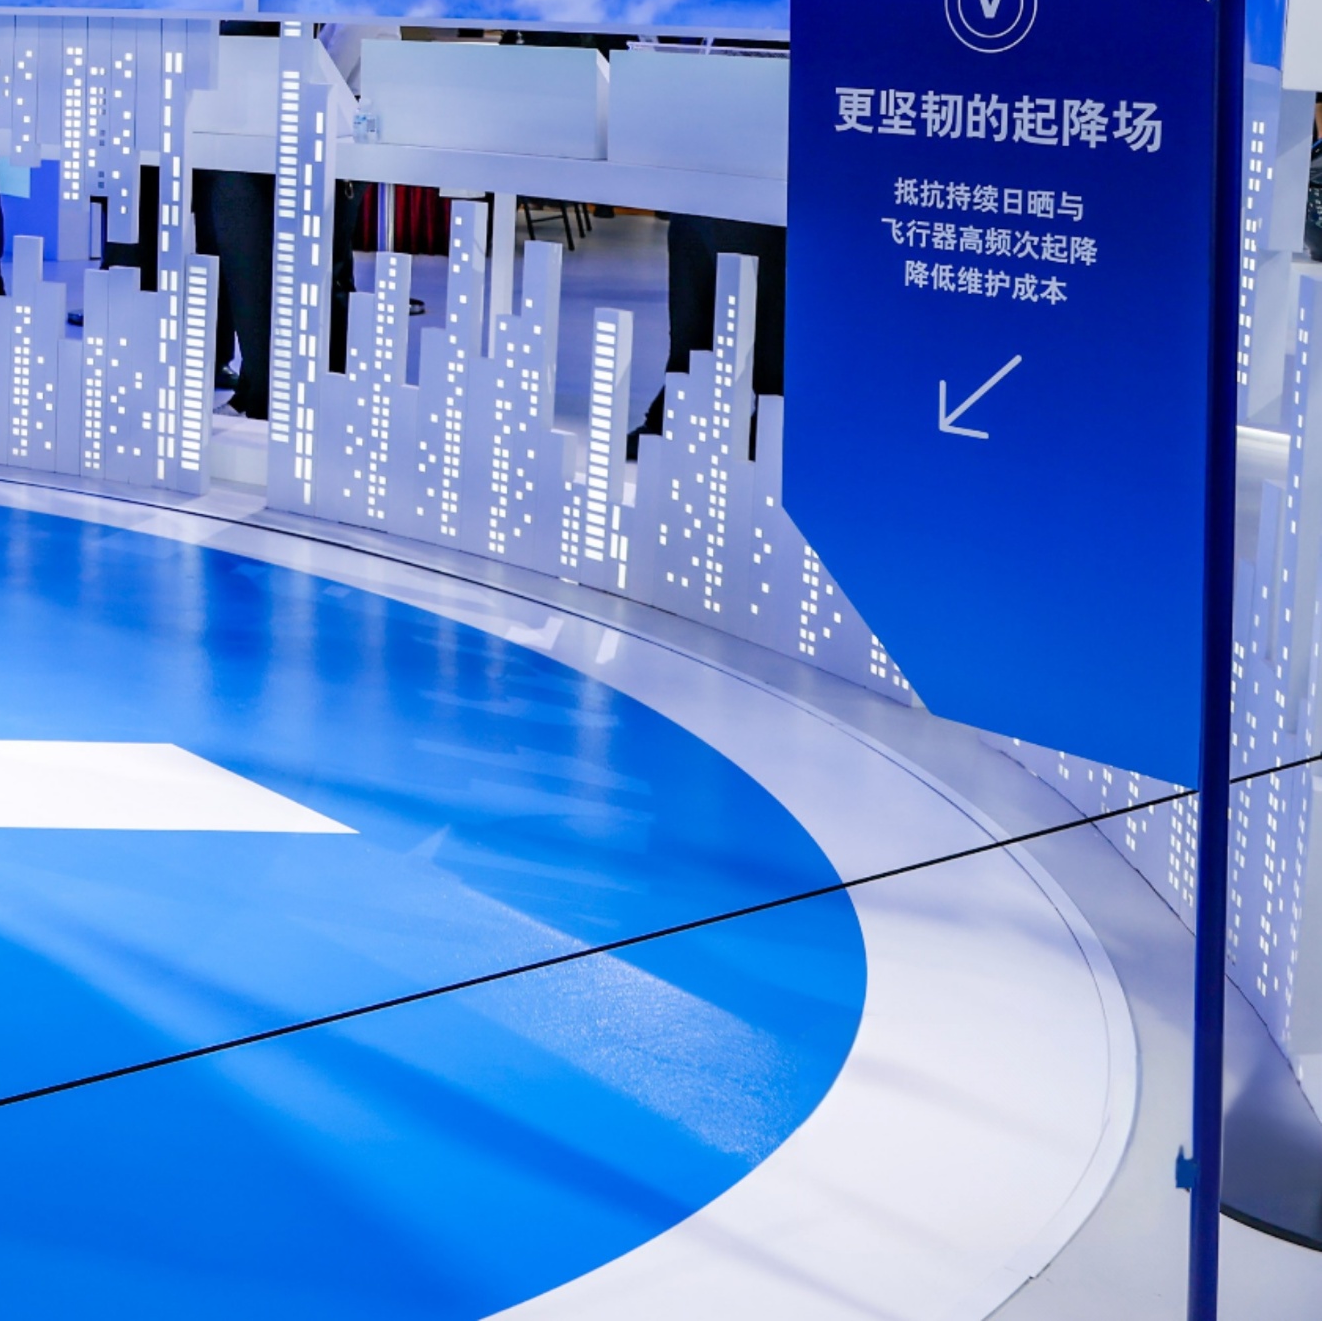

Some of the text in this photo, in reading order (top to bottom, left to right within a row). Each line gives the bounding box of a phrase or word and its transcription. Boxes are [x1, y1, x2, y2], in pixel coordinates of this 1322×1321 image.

[834, 86, 1163, 153] 更坚韧的起降场
[893, 176, 1084, 223] 抵抗持续日晒与
[881, 217, 1098, 267] 飞行器高频次起降
[904, 259, 1068, 305] 降低维护成本
